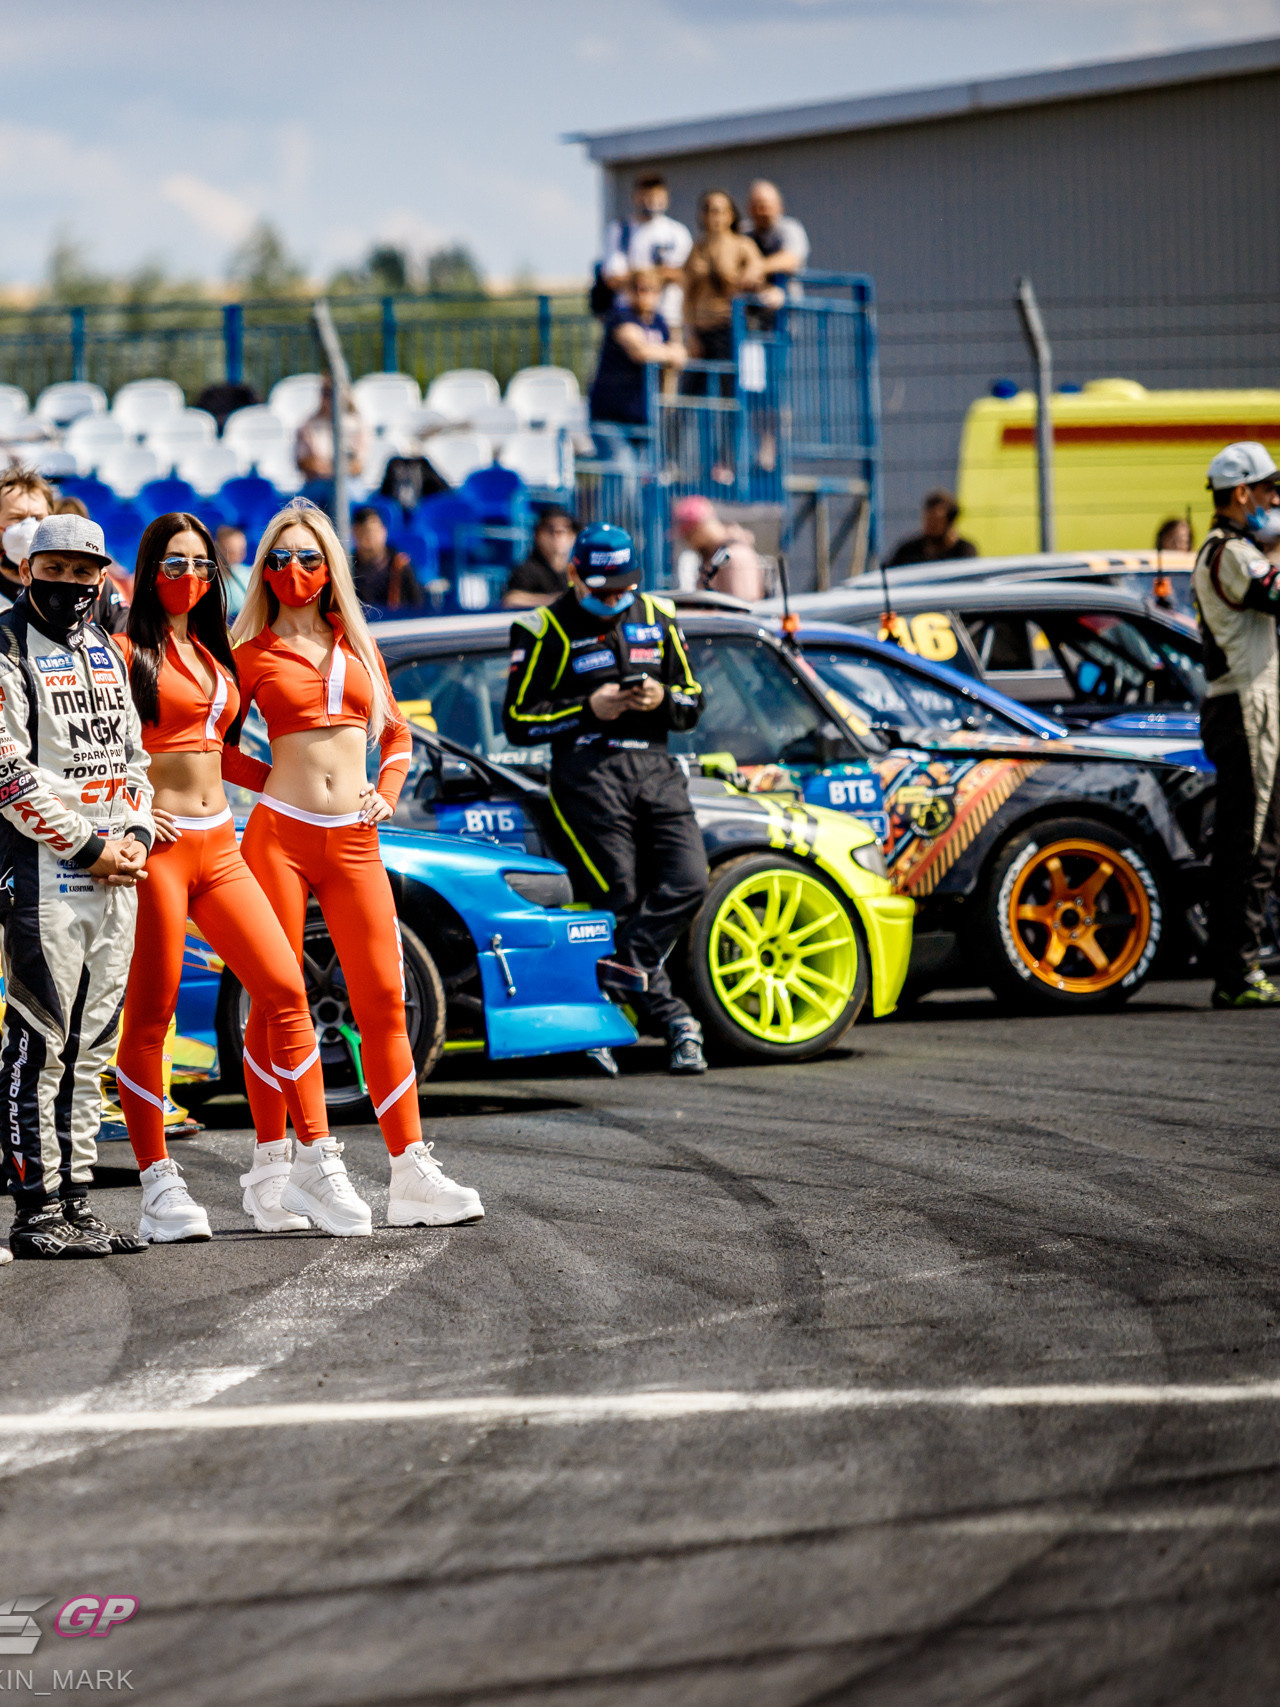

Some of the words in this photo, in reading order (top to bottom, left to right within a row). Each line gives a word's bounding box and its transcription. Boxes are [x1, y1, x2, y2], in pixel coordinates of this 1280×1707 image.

[45, 674, 77, 687] KYB
[51, 687, 125, 715] MAHLE
[67, 715, 124, 749] NGK
[73, 751, 105, 763] SPARK
[18, 773, 32, 787] GP
[63, 764, 107, 780] TOYO
[828, 779, 877, 805] ВТБ
[11, 800, 74, 852] KYB
[465, 809, 515, 833] ВТБ
[10, 1028, 29, 1098] FORWARD
[8, 1100, 21, 1146] AUTO
